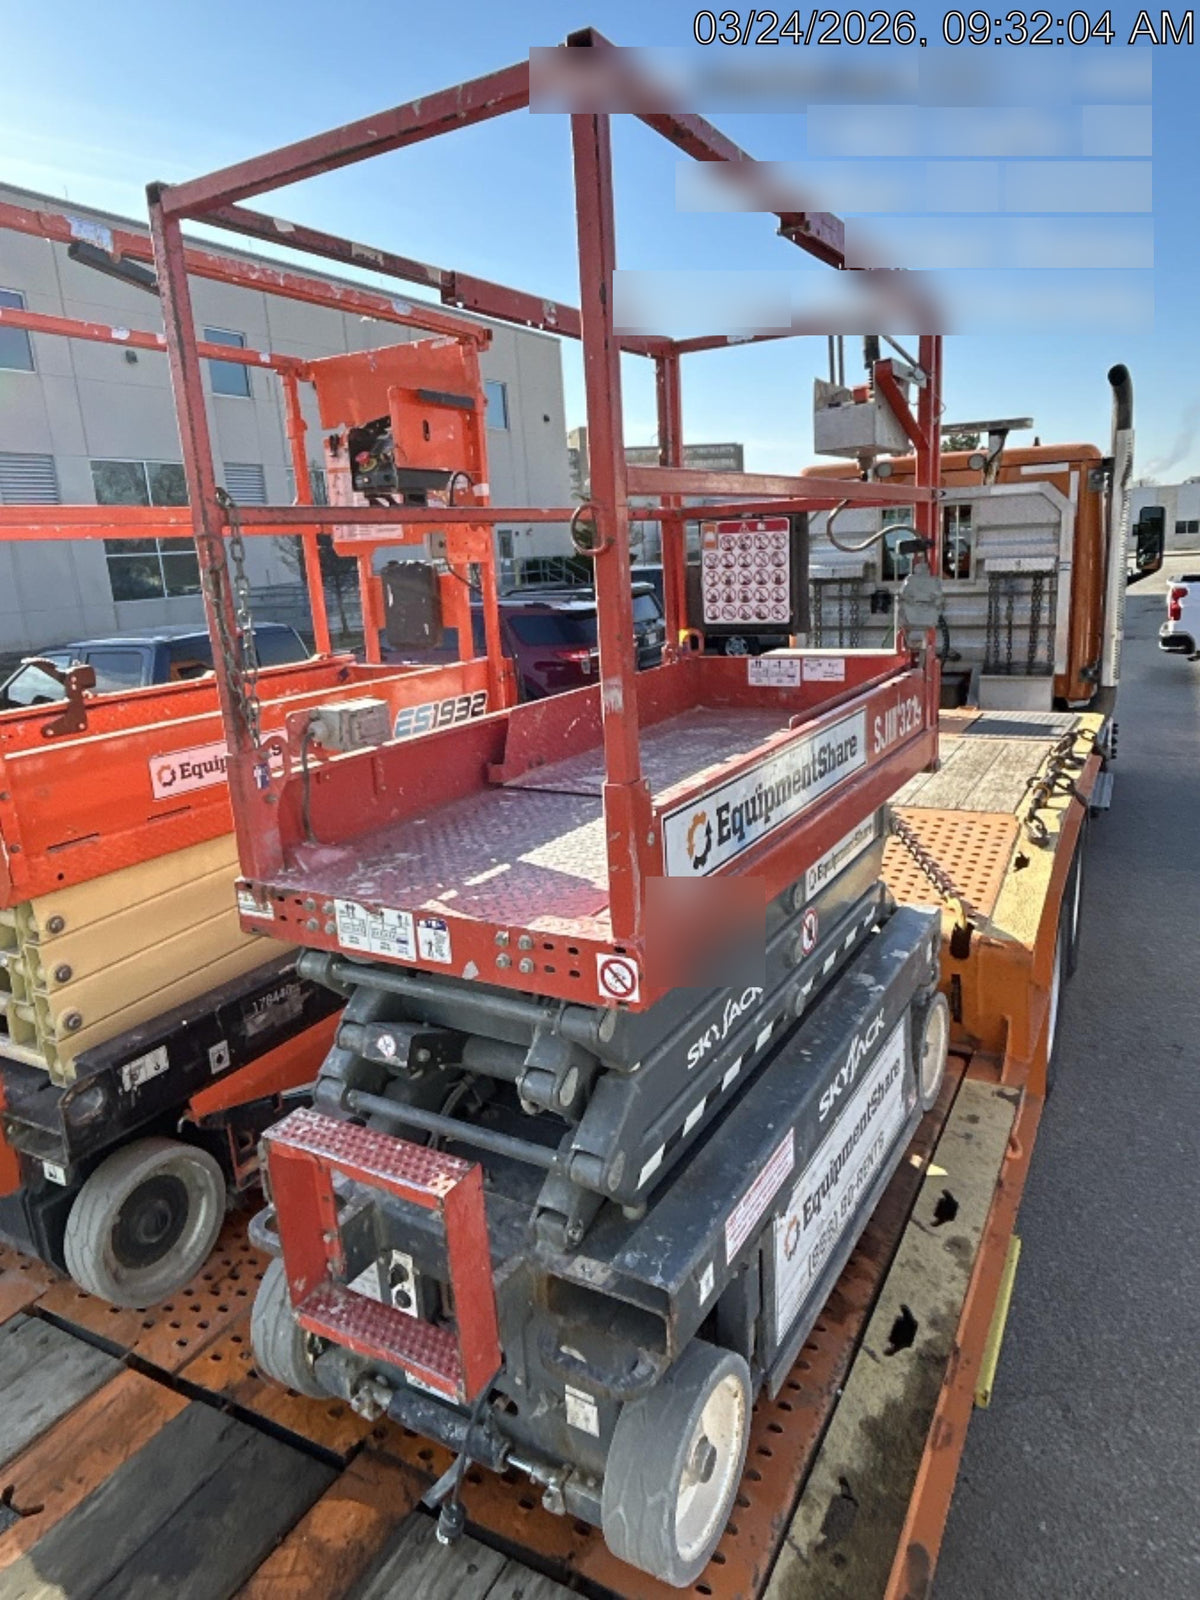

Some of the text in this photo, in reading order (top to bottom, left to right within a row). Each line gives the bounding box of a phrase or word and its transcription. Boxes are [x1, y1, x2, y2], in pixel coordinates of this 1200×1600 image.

[394, 692, 487, 738] ES1932
[716, 734, 858, 846] EquipmentShare
[819, 1006, 885, 1123] SKYJACK
[802, 1057, 901, 1231] EquipmentShare
